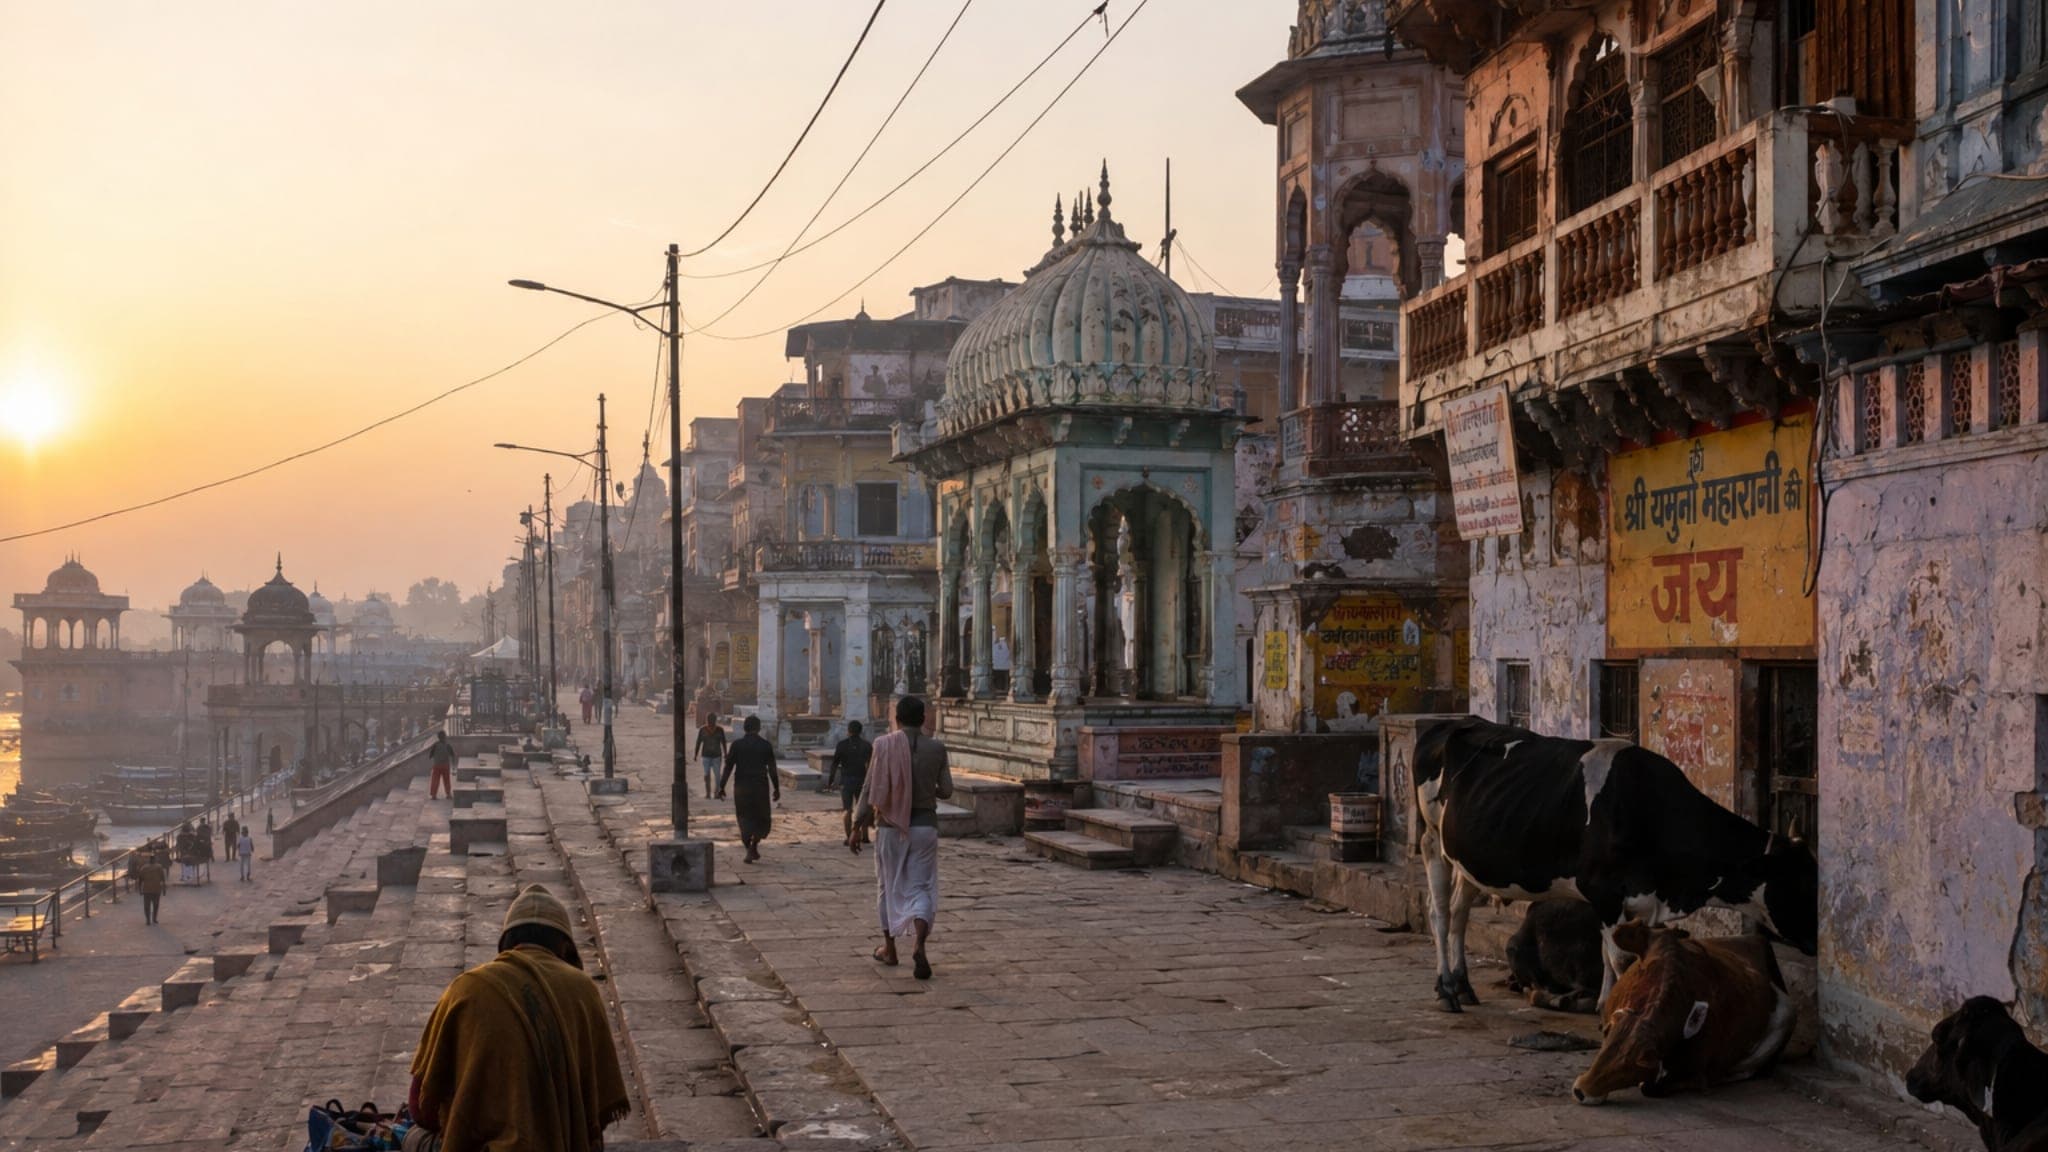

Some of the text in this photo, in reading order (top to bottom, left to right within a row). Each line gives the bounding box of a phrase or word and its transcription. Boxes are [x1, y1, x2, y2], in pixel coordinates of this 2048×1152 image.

[1624, 476, 1648, 531] श्री
[1701, 450, 1782, 526] महारानी
[1784, 468, 1803, 511] की
[1651, 547, 1744, 624] जय
